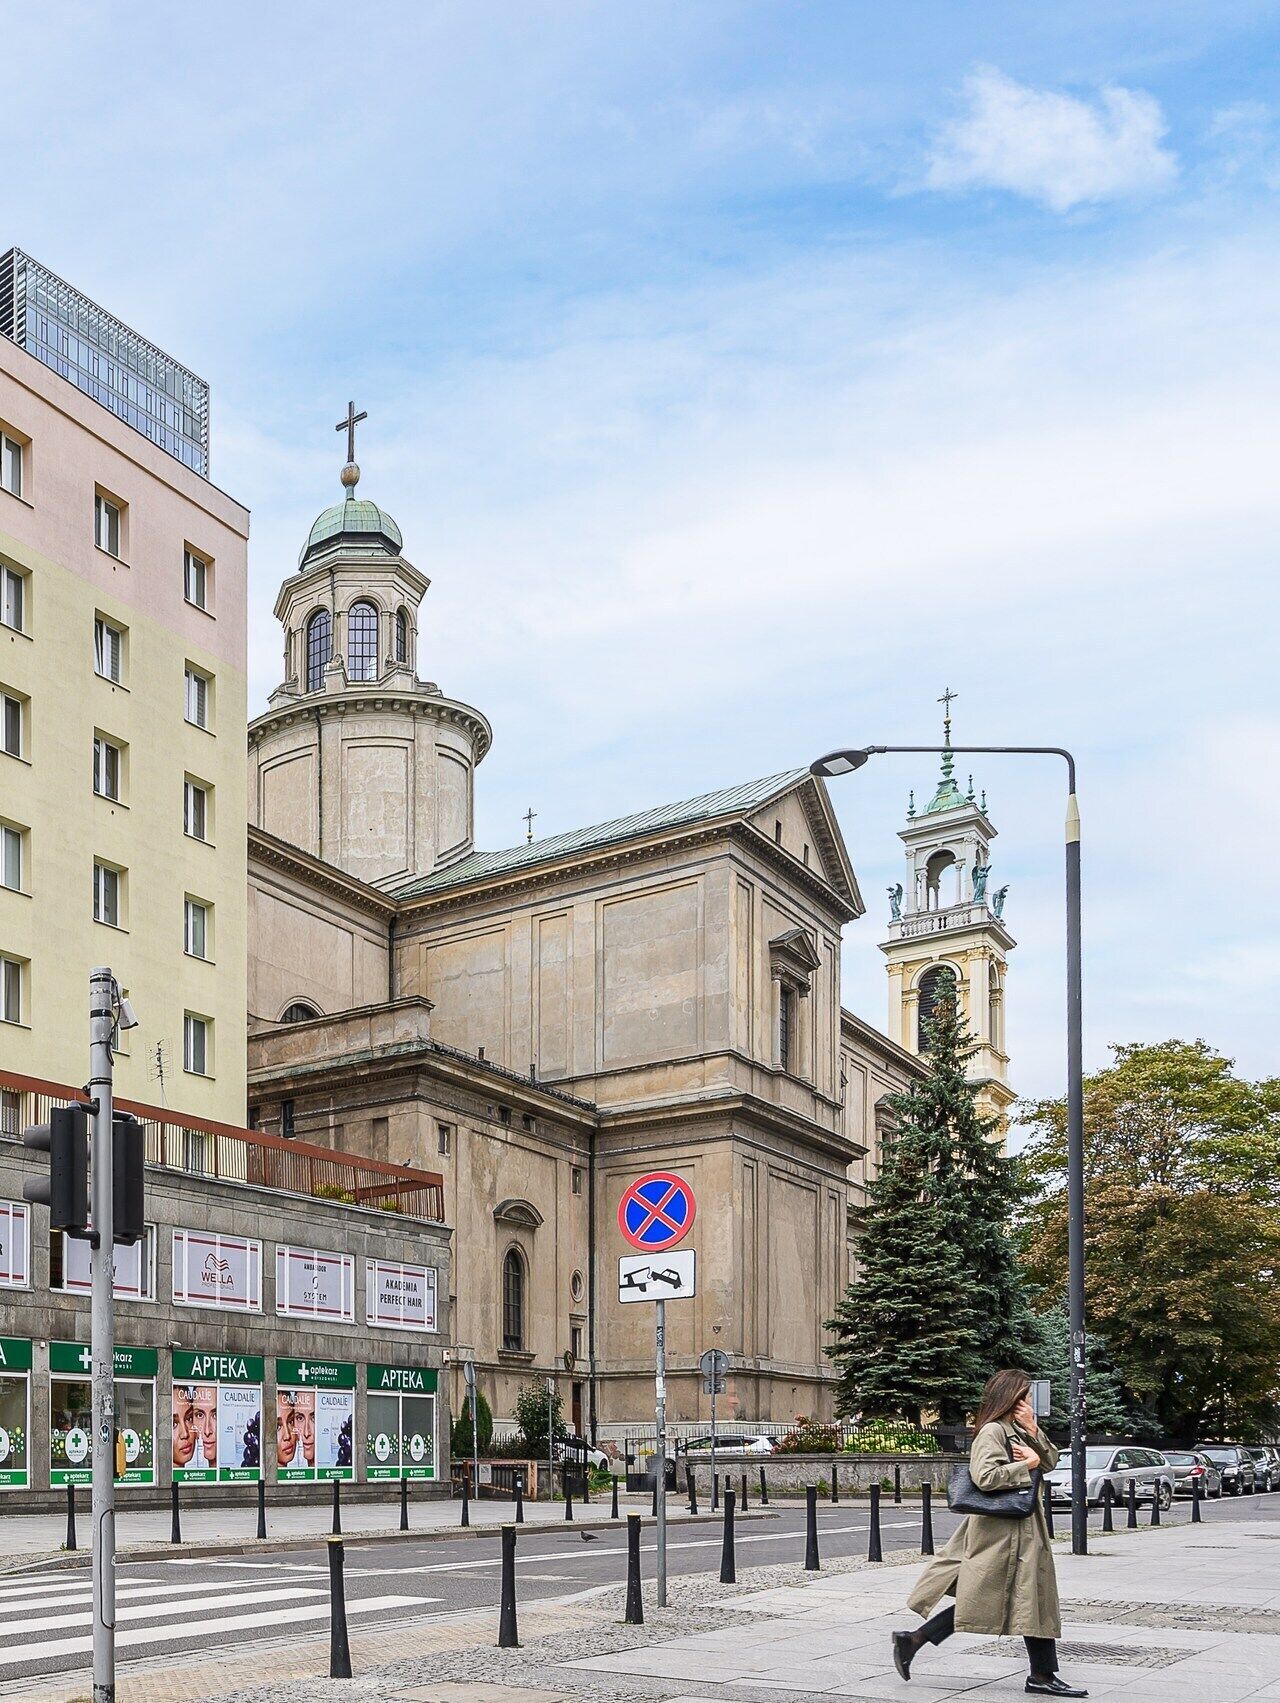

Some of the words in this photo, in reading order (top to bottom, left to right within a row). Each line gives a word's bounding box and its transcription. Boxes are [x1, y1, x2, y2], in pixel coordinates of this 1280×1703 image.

[201, 1271, 234, 1285] WELLA
[385, 1278, 418, 1293] AKADEMIA
[379, 1293, 407, 1306] PERFECT
[407, 1296, 422, 1308] HAIR
[112, 1351, 133, 1363] ekarz
[191, 1356, 248, 1379] APTEKA
[310, 1366, 338, 1377] aptekarz
[380, 1369, 425, 1389] APTEKA
